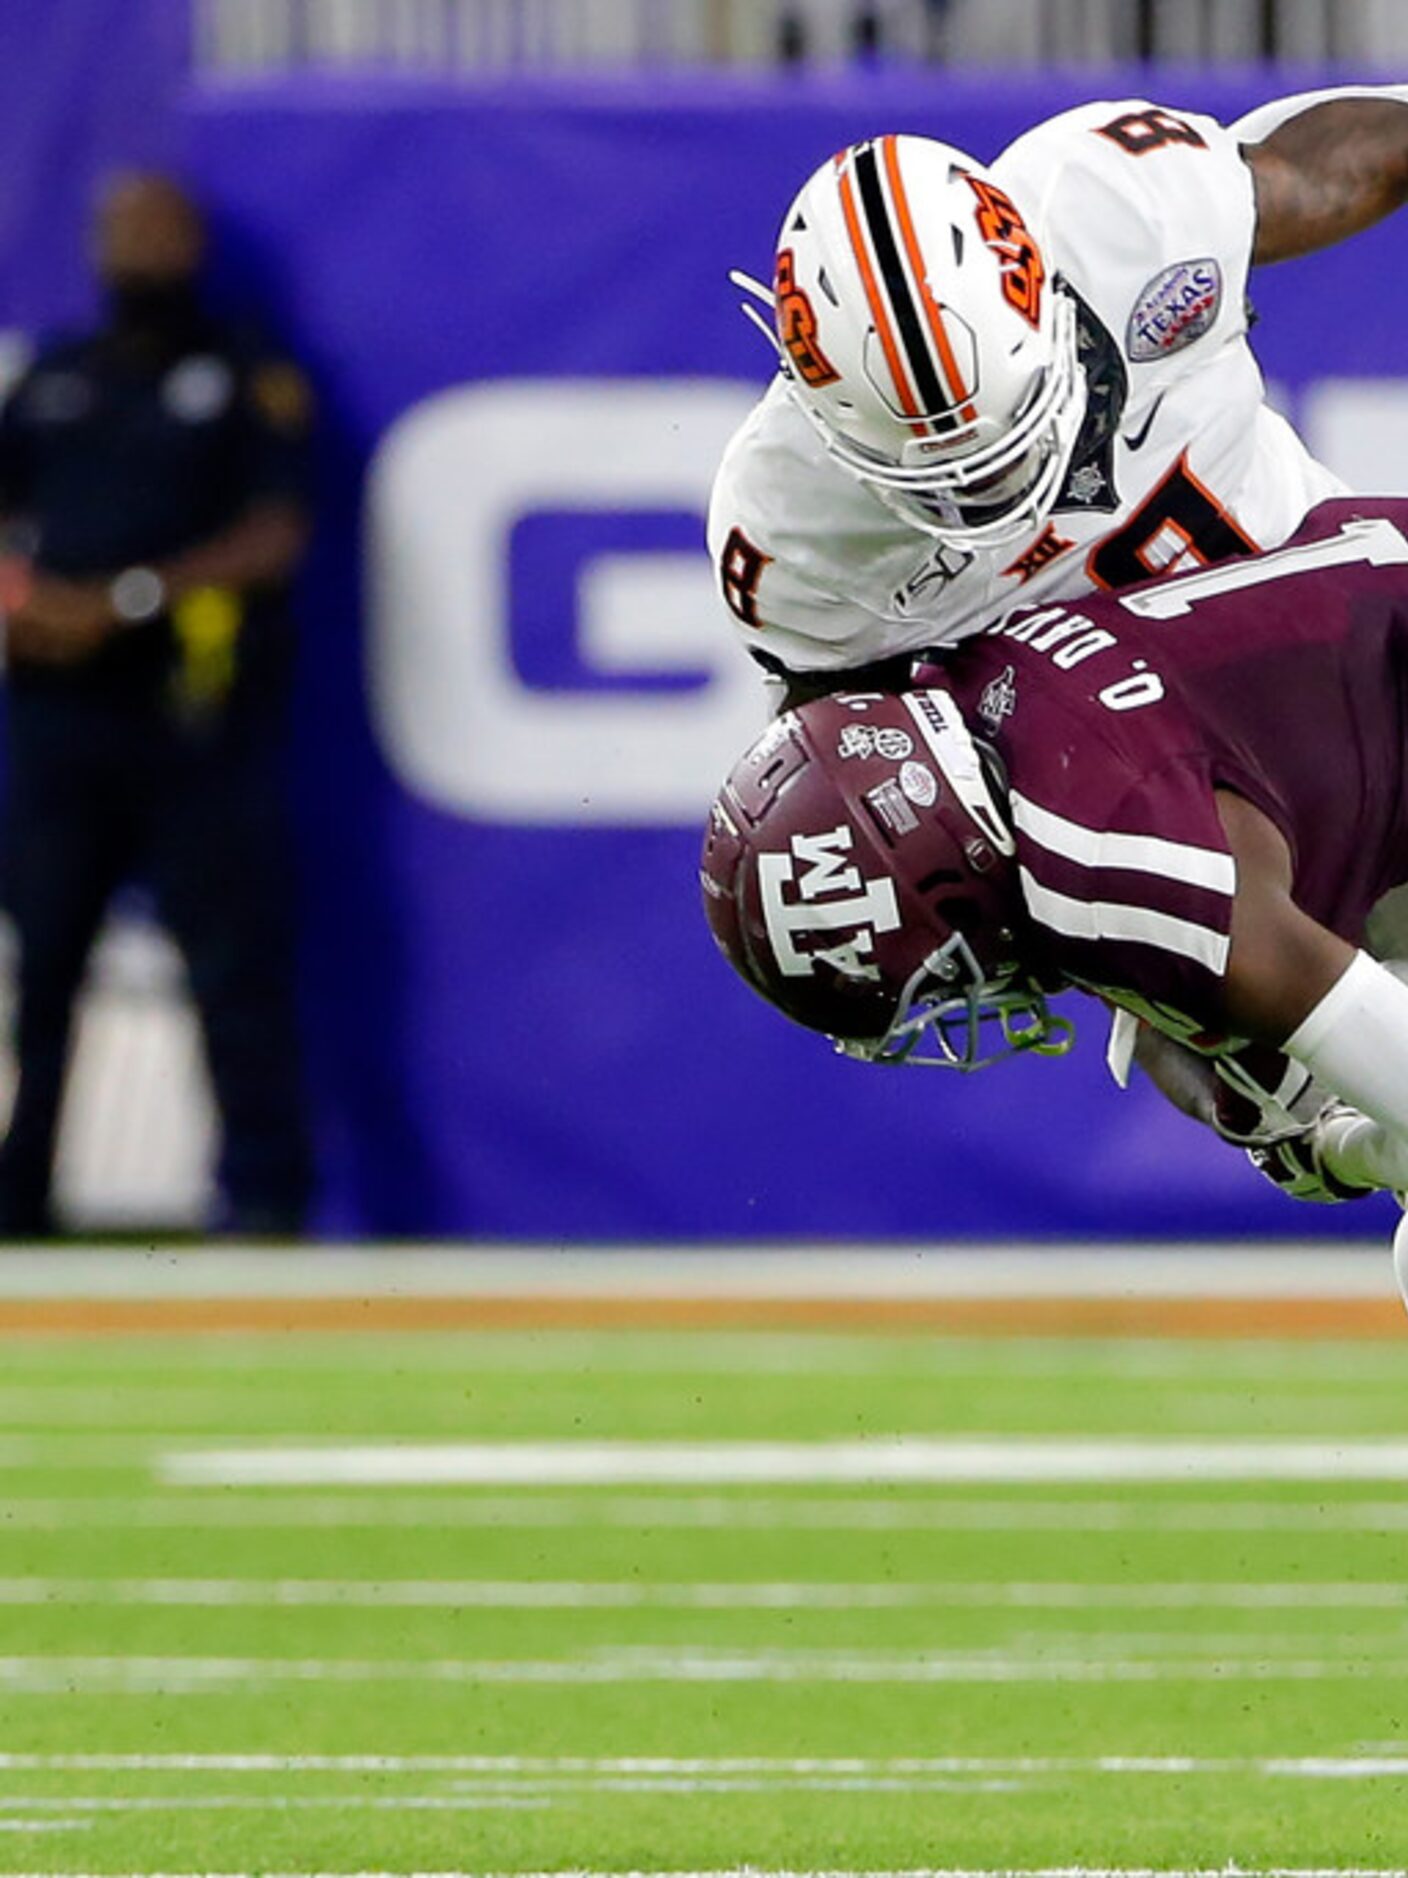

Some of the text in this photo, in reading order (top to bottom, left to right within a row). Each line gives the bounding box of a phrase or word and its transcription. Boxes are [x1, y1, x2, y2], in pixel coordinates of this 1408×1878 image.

[1089, 108, 1210, 157] 8
[1137, 267, 1216, 347] TEXAS
[719, 525, 775, 630] 8
